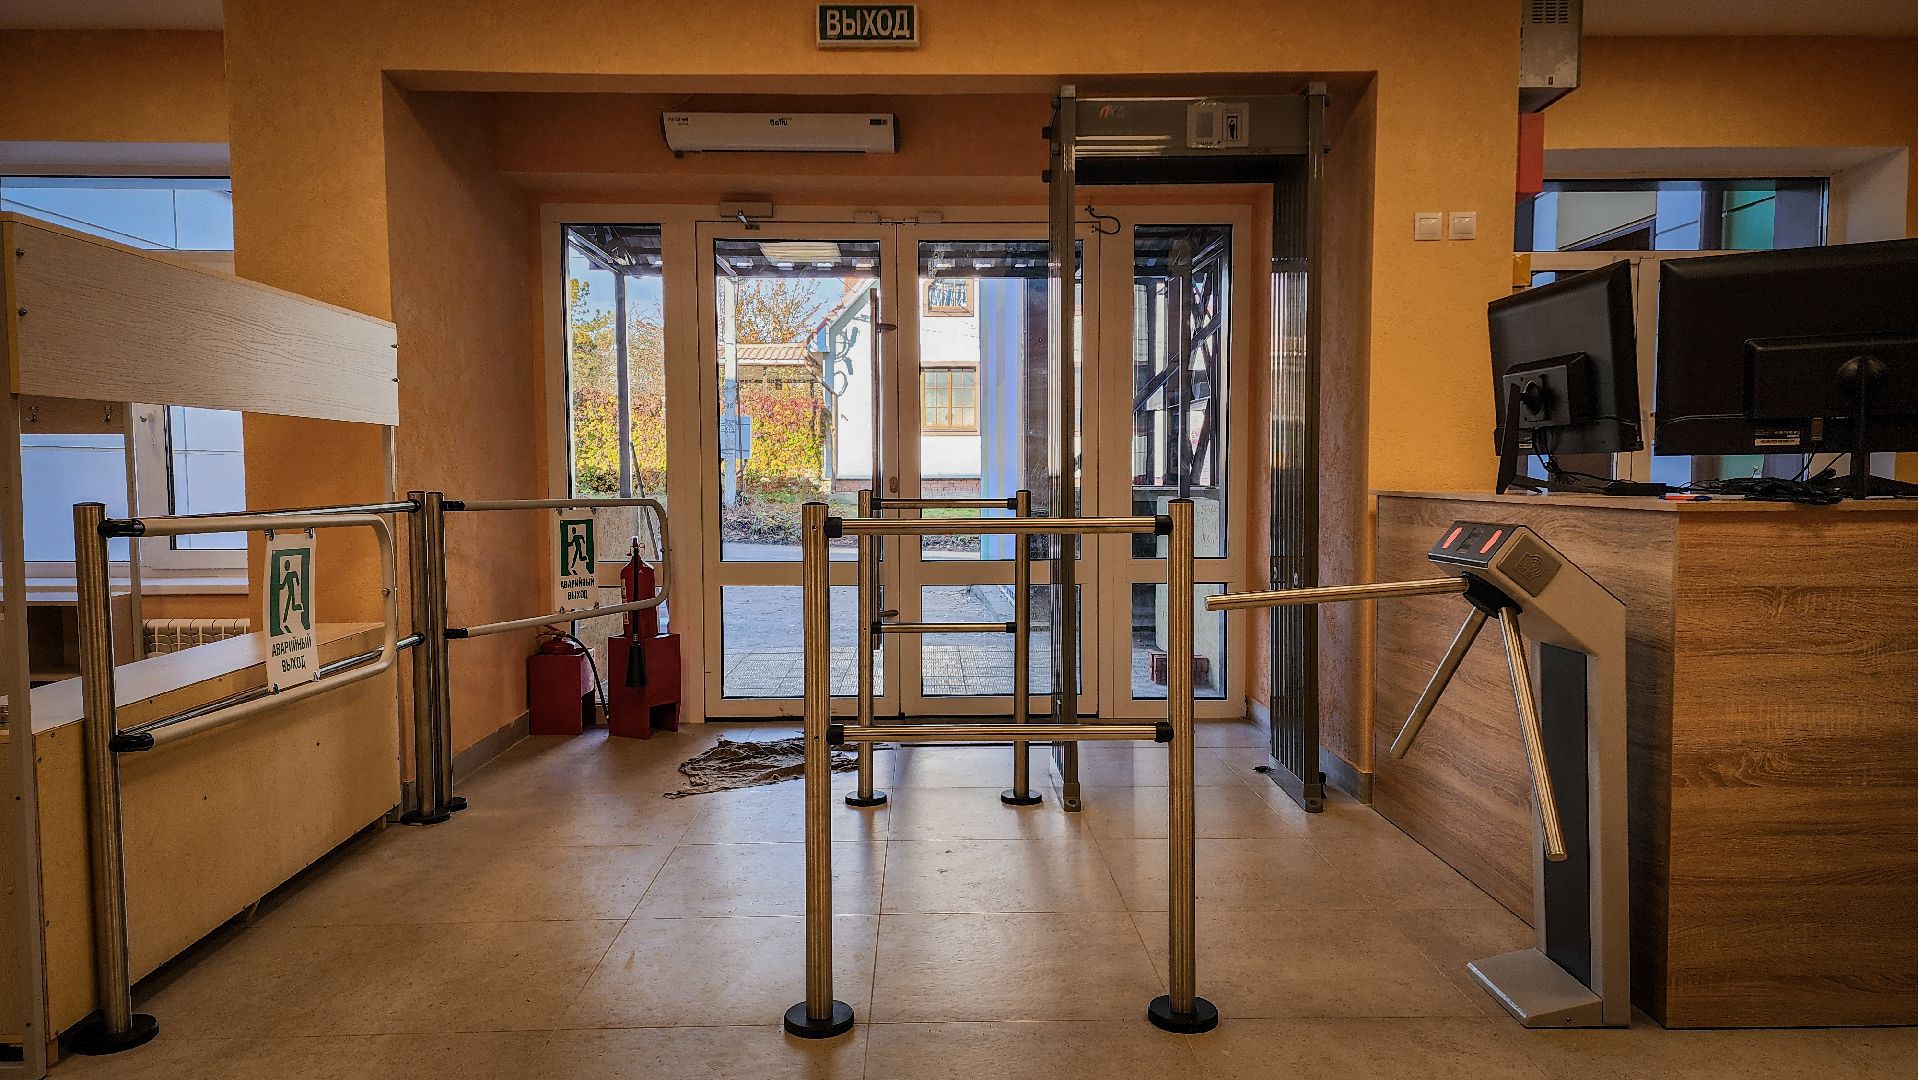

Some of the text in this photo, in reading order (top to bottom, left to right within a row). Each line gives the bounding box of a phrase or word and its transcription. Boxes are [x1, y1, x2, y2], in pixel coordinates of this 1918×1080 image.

[826, 9, 911, 39] ВЫХОД
[560, 575, 595, 589] АВАРИЙНЫЙ
[567, 589, 588, 600] ВЫХОД
[271, 633, 312, 657] АВАРИЙНЫЙ
[281, 655, 307, 673] ВЫХОД
